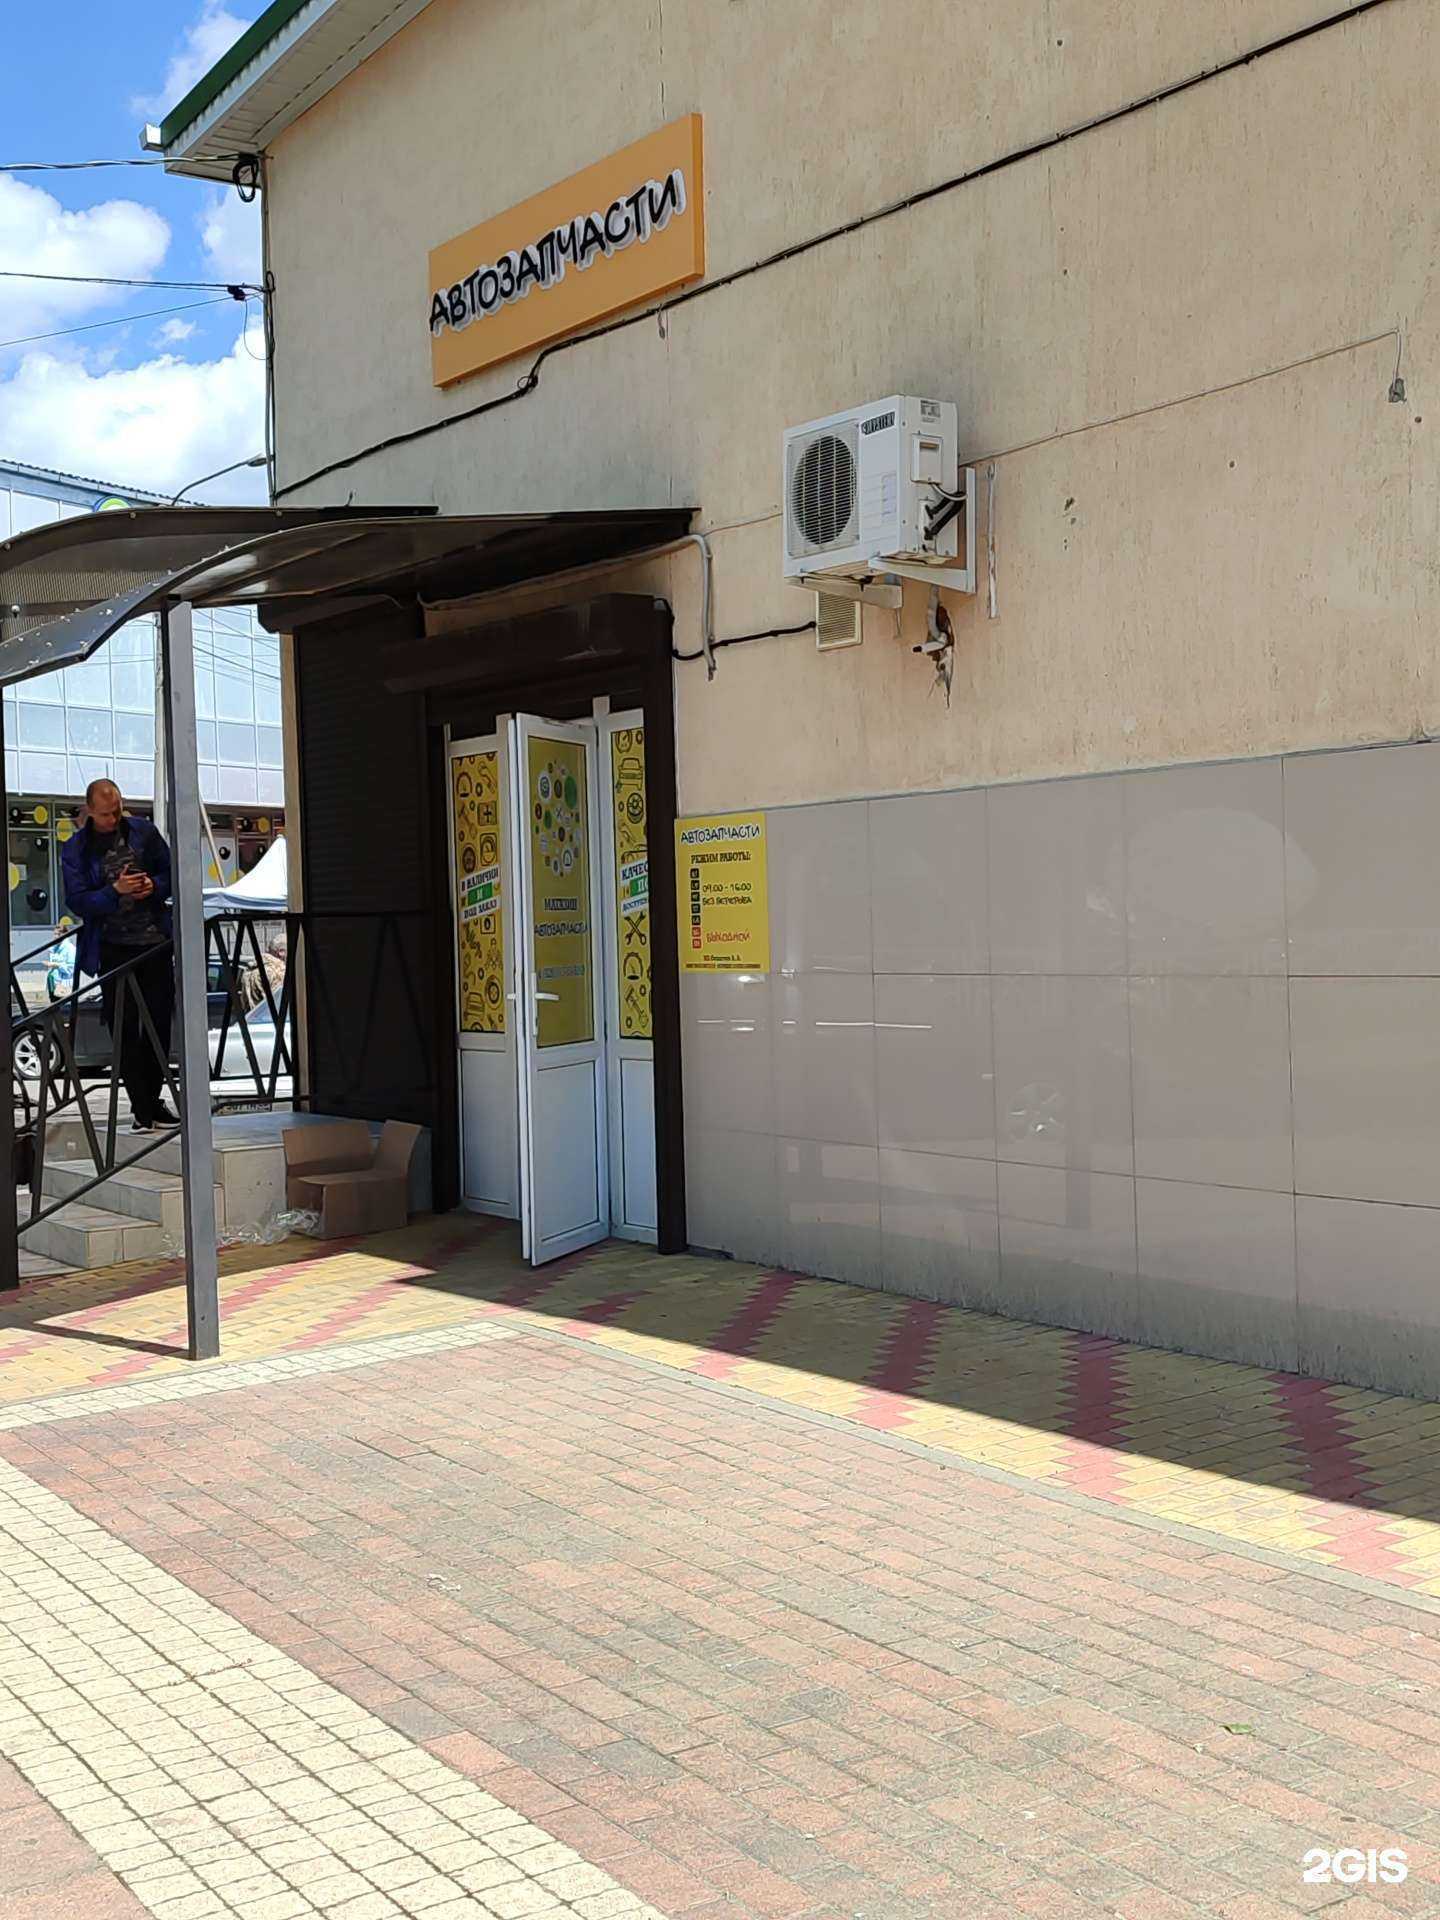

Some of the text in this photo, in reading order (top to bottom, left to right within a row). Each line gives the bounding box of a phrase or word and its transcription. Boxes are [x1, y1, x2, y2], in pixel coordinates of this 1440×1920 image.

[429, 170, 686, 336] АВТОЗАПЧАСТИ
[681, 825, 760, 843] АВТОЗАПЧАСТИ
[691, 853, 718, 864] РЕЖИМ
